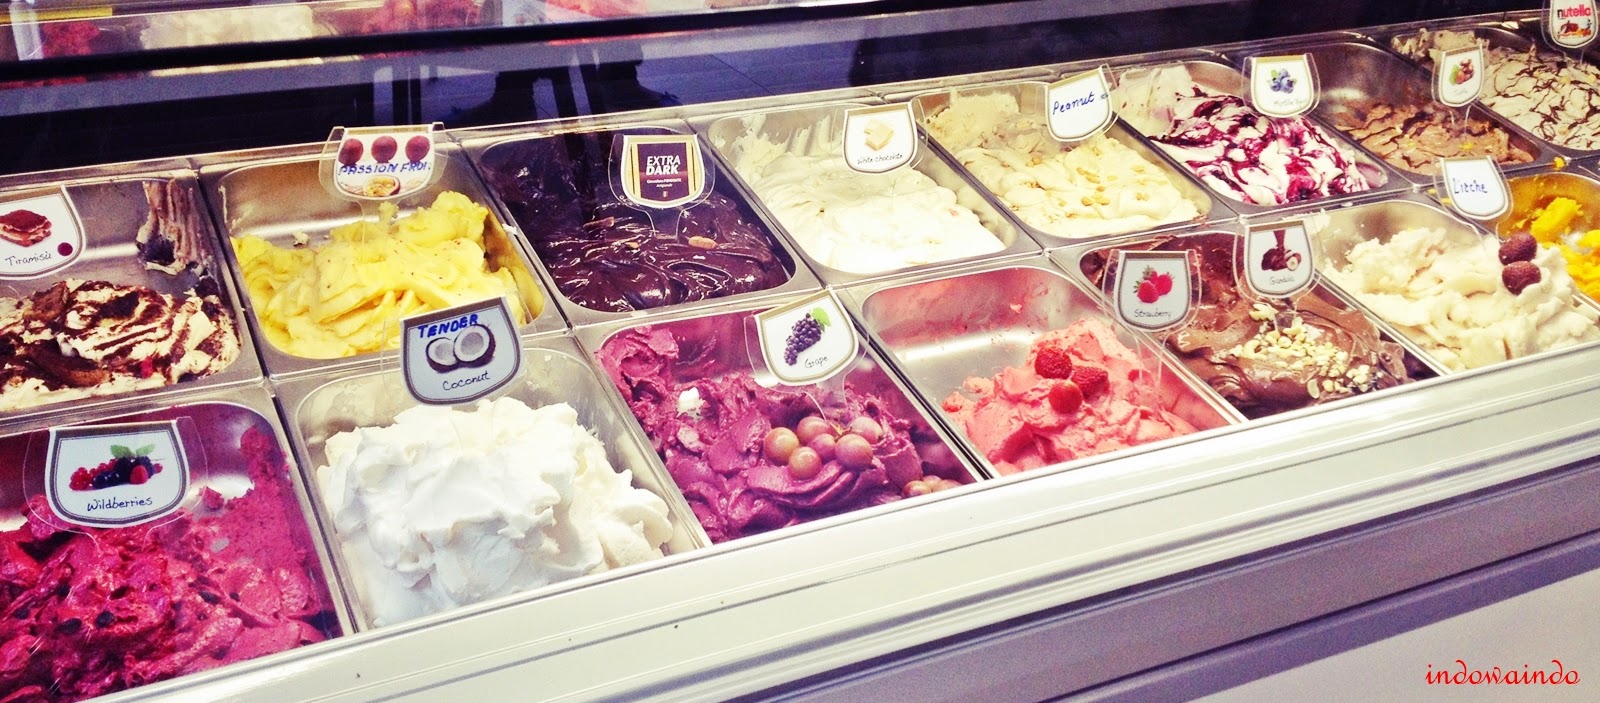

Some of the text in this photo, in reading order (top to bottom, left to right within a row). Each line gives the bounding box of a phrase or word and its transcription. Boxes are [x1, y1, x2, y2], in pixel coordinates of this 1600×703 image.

[1556, 4, 1592, 18] nutella
[1052, 91, 1095, 115] Peanut
[646, 155, 681, 166] EXTRA
[338, 161, 432, 175] PASSION FRUI
[645, 165, 679, 175] DARK
[1134, 308, 1172, 319] Strawberry
[418, 313, 478, 338] TENDER
[804, 356, 828, 368] Grape
[442, 370, 490, 391] Coconut
[86, 496, 153, 511] Wildberries
